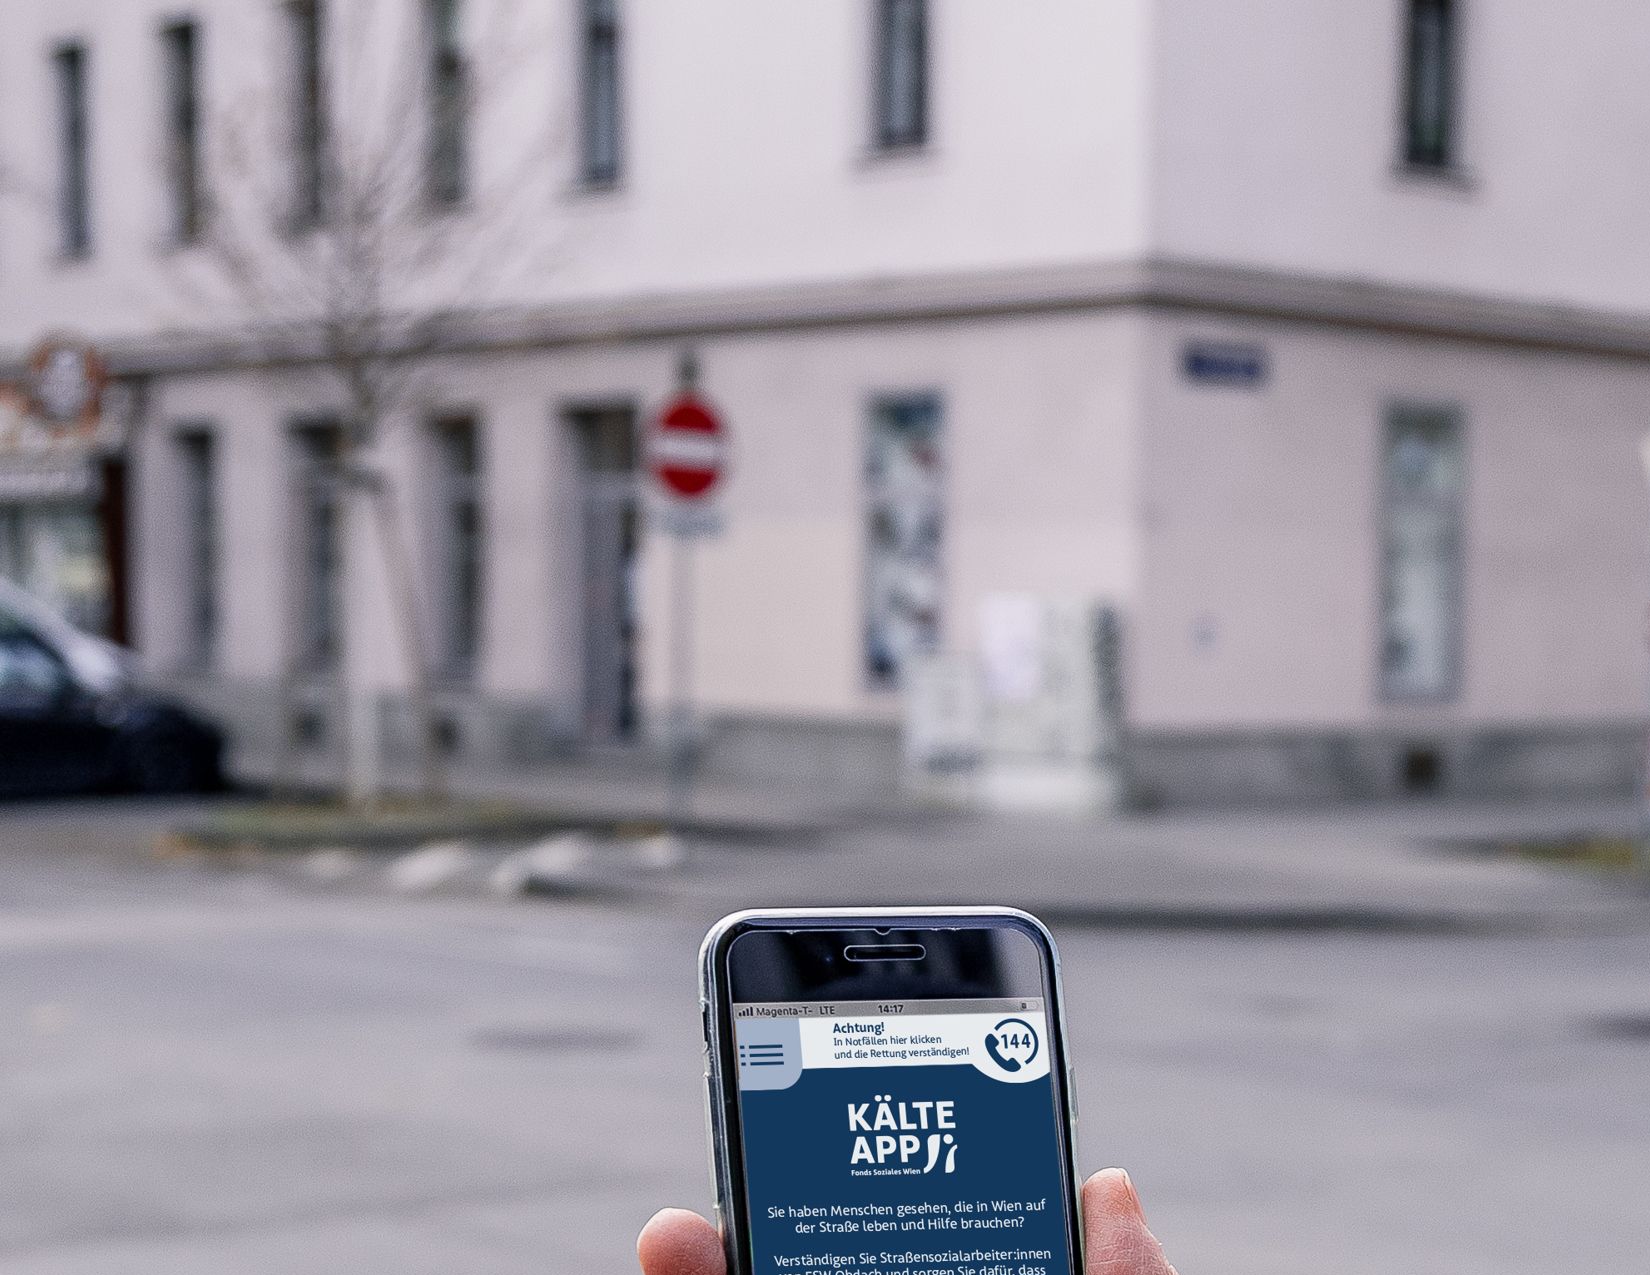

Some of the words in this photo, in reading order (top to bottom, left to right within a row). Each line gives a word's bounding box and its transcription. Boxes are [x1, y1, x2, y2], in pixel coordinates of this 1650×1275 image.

[820, 1006, 835, 1015] LTE
[878, 1004, 904, 1013] 14:17
[833, 1022, 885, 1035] Achtung!
[834, 1038, 843, 1046] In
[845, 1036, 888, 1046] Notfällen
[890, 1036, 907, 1045] hier
[910, 1035, 942, 1044] klicken
[1001, 1033, 1031, 1049] 144
[834, 1049, 852, 1059] und
[854, 1049, 868, 1059] die
[870, 1048, 907, 1059] Rettung
[908, 1047, 970, 1058] verständigen!
[847, 1094, 956, 1131] KÄLTE
[850, 1135, 920, 1164] APP
[873, 1168, 902, 1176] Soziales
[767, 1206, 785, 1218] Sie
[789, 1205, 827, 1218] haben
[830, 1203, 893, 1217] Menschen
[897, 1202, 951, 1217] gesehen,
[954, 1201, 973, 1213] die
[976, 1201, 988, 1213] in
[991, 1200, 1022, 1212] Wien
[1026, 1198, 1046, 1211] auf
[795, 1222, 816, 1234] der
[819, 1220, 859, 1233] Straße
[862, 1220, 897, 1232] leben
[901, 1219, 925, 1231] und
[928, 1218, 957, 1230] Hilfe
[961, 1216, 1025, 1229] brauchen?
[774, 1253, 856, 1268] Verständigen
[859, 1252, 877, 1264] Sie
[880, 1249, 1051, 1264] Straßensozialarbeiter:innen
[1018, 1264, 1046, 1275] dass
